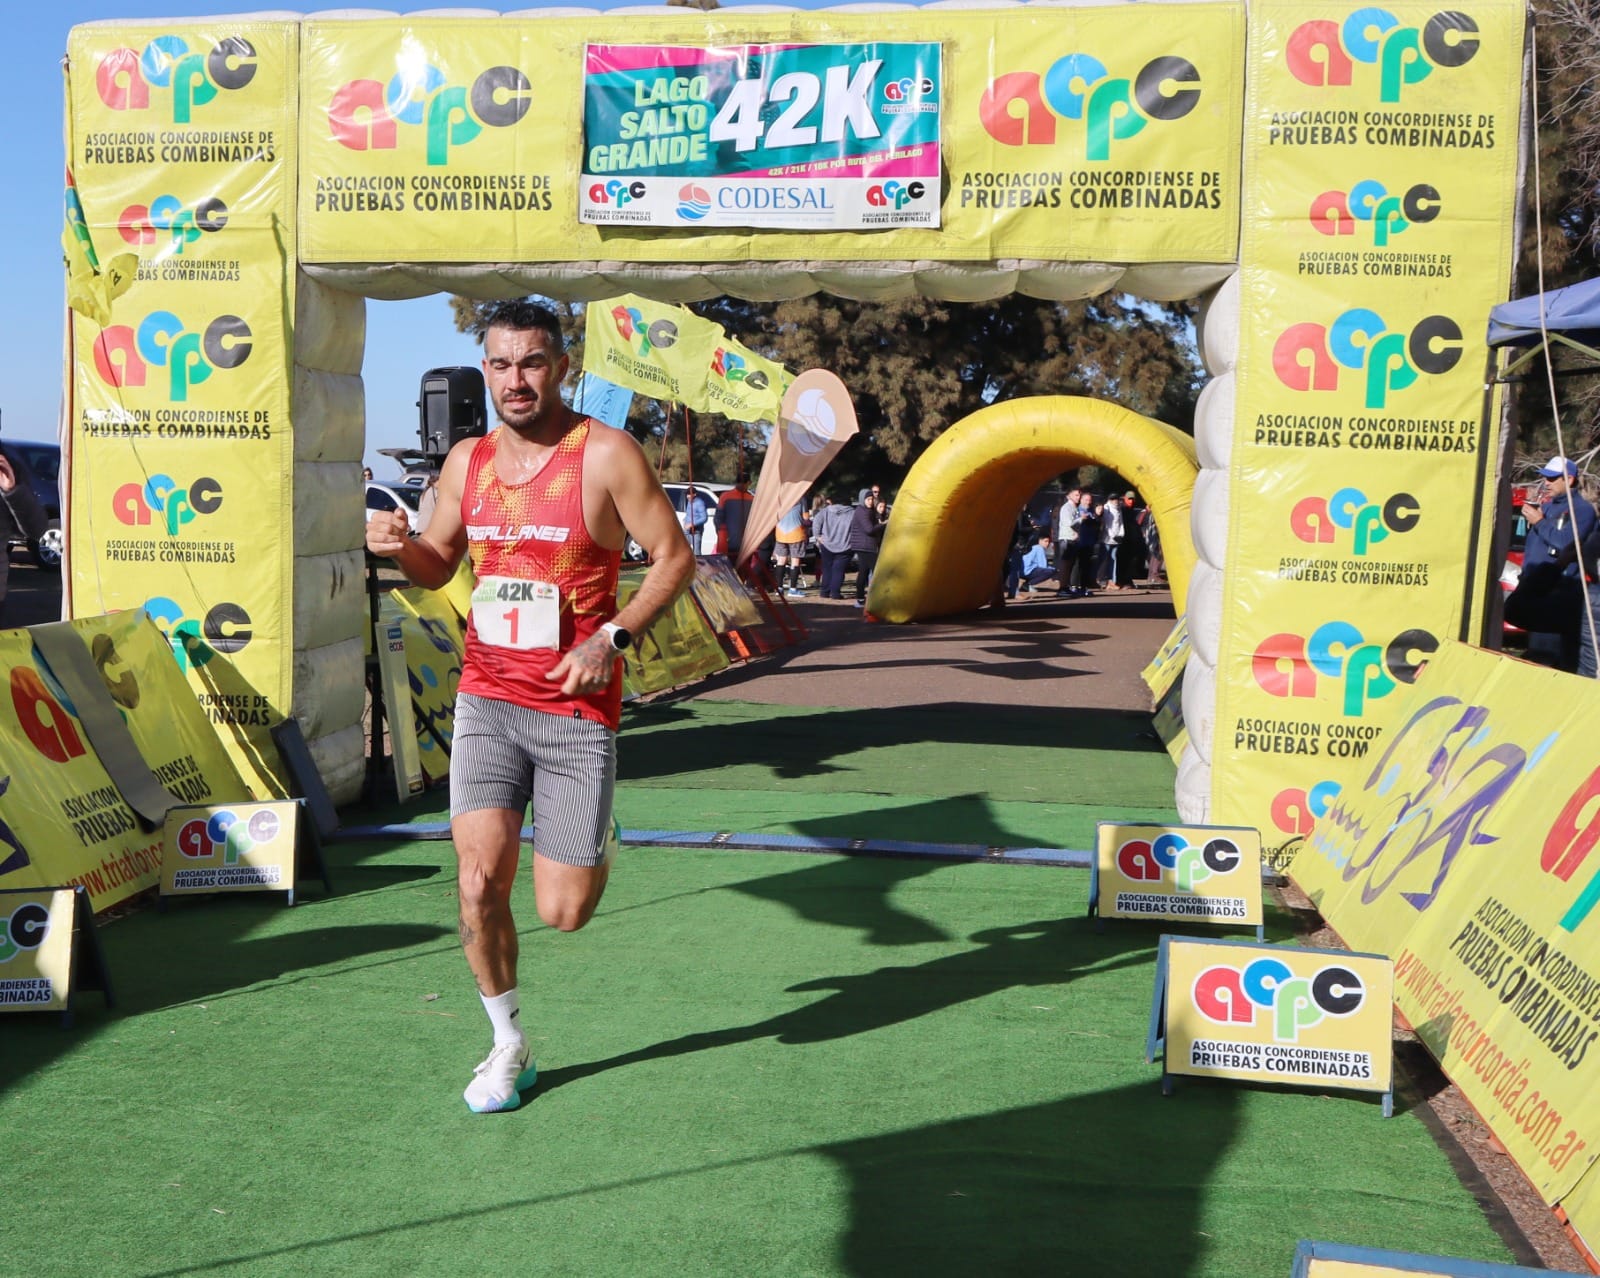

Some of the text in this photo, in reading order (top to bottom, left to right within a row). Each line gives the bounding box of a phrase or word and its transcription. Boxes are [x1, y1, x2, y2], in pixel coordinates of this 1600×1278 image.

[635, 75, 709, 107] LAGO
[709, 59, 883, 152] 42K
[619, 104, 707, 140] SALTO
[1271, 111, 1495, 129] ASOCIACION CONCORDIENSE DE
[86, 131, 274, 146] ASOCIACION CONCORDIENSE DE
[1270, 127, 1495, 149] PRUEBAS COMBINADAS
[85, 144, 276, 164] PRUEBAS COMBINADAS
[589, 133, 708, 173] GRANDE
[316, 175, 550, 191] ASOCIACION CONCORDIENSE DE
[962, 171, 1220, 188] ASOCIACION CONCORDIENSE DE
[315, 191, 553, 212] PRUEBAS COMBINADAS
[718, 187, 834, 209] CODESAL
[960, 188, 1222, 210] PRUEBAS COMBINADAS
[162, 259, 226, 269] CONCORDIENSE
[229, 260, 240, 269] DE
[1300, 252, 1452, 264] ASOCIACION CONCORDIENSE DE
[162, 269, 240, 282] COMBINADAS
[1299, 262, 1452, 278] PRUEBAS COMBINADAS
[156, 409, 249, 423] CONCORDIENSE
[255, 410, 269, 423] DE
[1256, 414, 1476, 435] ASOCIACION CONCORDIENSE DE
[157, 423, 271, 440] COMBINADAS
[1255, 429, 1476, 453] PRUEBAS COMBINADAS
[106, 540, 234, 551] ASOCIACION CONCORDIENSE DE
[106, 549, 236, 563] PRUEBAS COMBINADAS
[1280, 557, 1428, 573] ASOCIACION CONCORDIENSE DE
[1279, 567, 1429, 586] PRUEBAS COMBINADAS
[497, 582, 534, 602] 42K
[503, 607, 519, 644] 1
[253, 695, 268, 708] DE
[1236, 718, 1321, 737] ASOCIACION
[1235, 732, 1319, 755] PRUEBAS
[61, 785, 120, 820] ASOCIACION
[73, 805, 136, 847] PRUEBAS
[175, 874, 280, 888] PRUEBAS COMBINADAS
[176, 866, 279, 878] ASOCIACION CONCORDIENSE DE
[1117, 901, 1245, 917] PRUEBAS COMBINADAS
[1118, 893, 1245, 907] ASOCIACION CONCORDIENSE DE
[1475, 896, 1536, 955] ASOCIACION
[1450, 920, 1514, 990] PRUEBAS
[40, 979, 51, 989] DE
[1192, 1041, 1369, 1064] ASOCIACION CONCORDIENSE DE
[1192, 1051, 1371, 1079] PRUEBAS COMBINADAS
